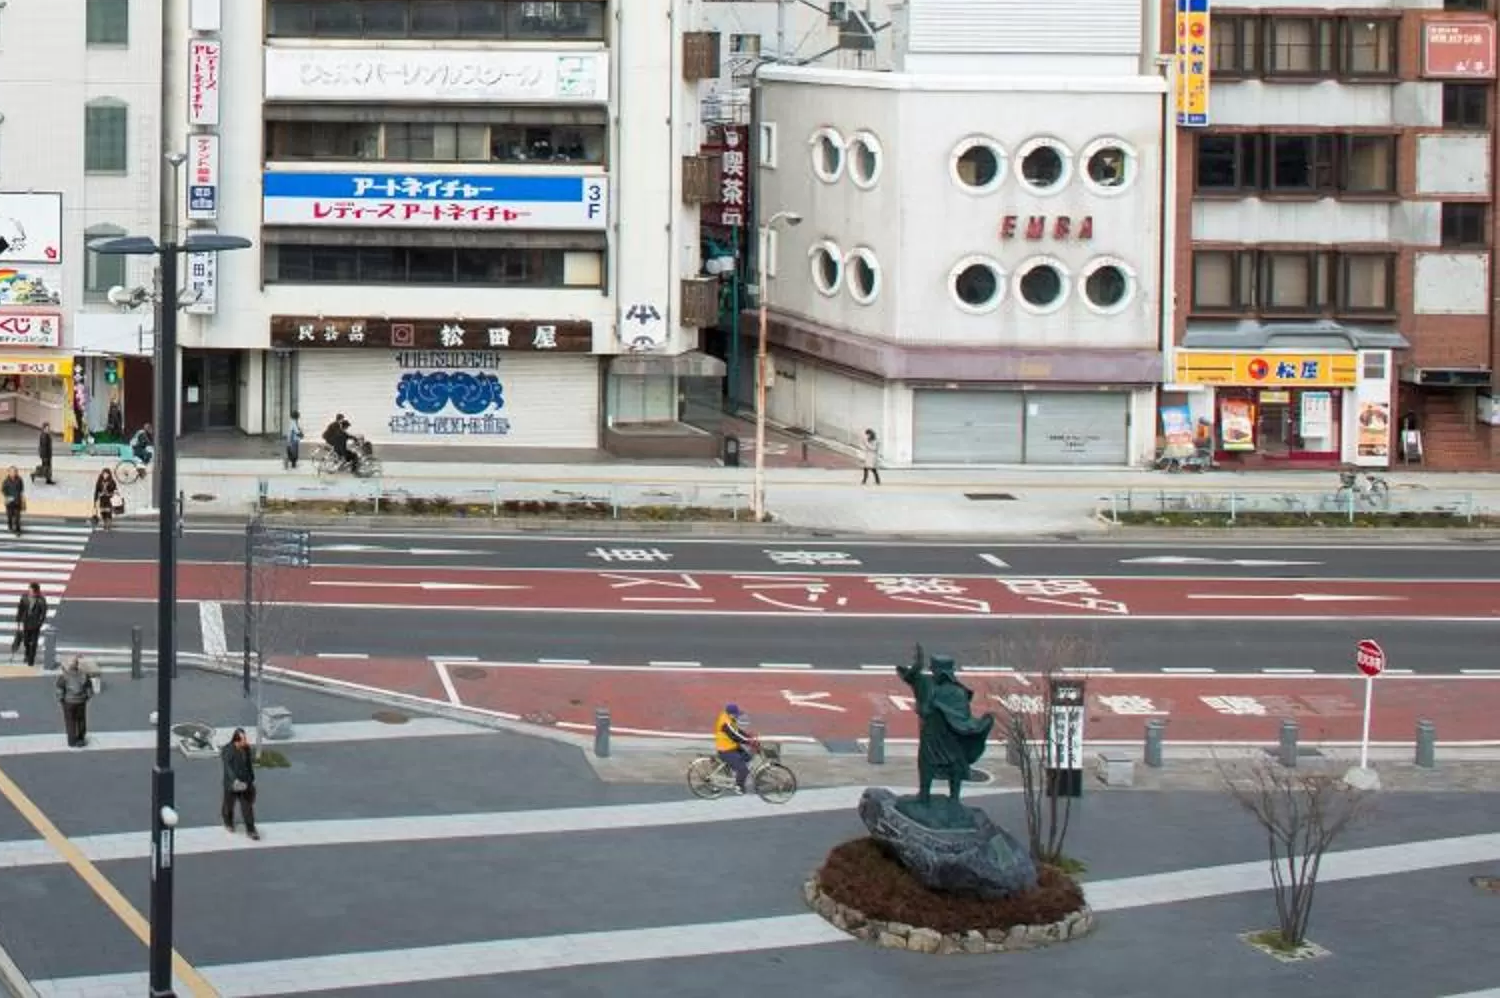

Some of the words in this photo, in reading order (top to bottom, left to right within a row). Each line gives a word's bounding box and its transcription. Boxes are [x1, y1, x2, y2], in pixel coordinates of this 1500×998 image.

[353, 177, 494, 197] アートネイチャー
[313, 201, 395, 220] レディース
[403, 202, 532, 221] アートネイチャー
[440, 324, 558, 348] 松田屋
[1275, 360, 1319, 379] 松屋
